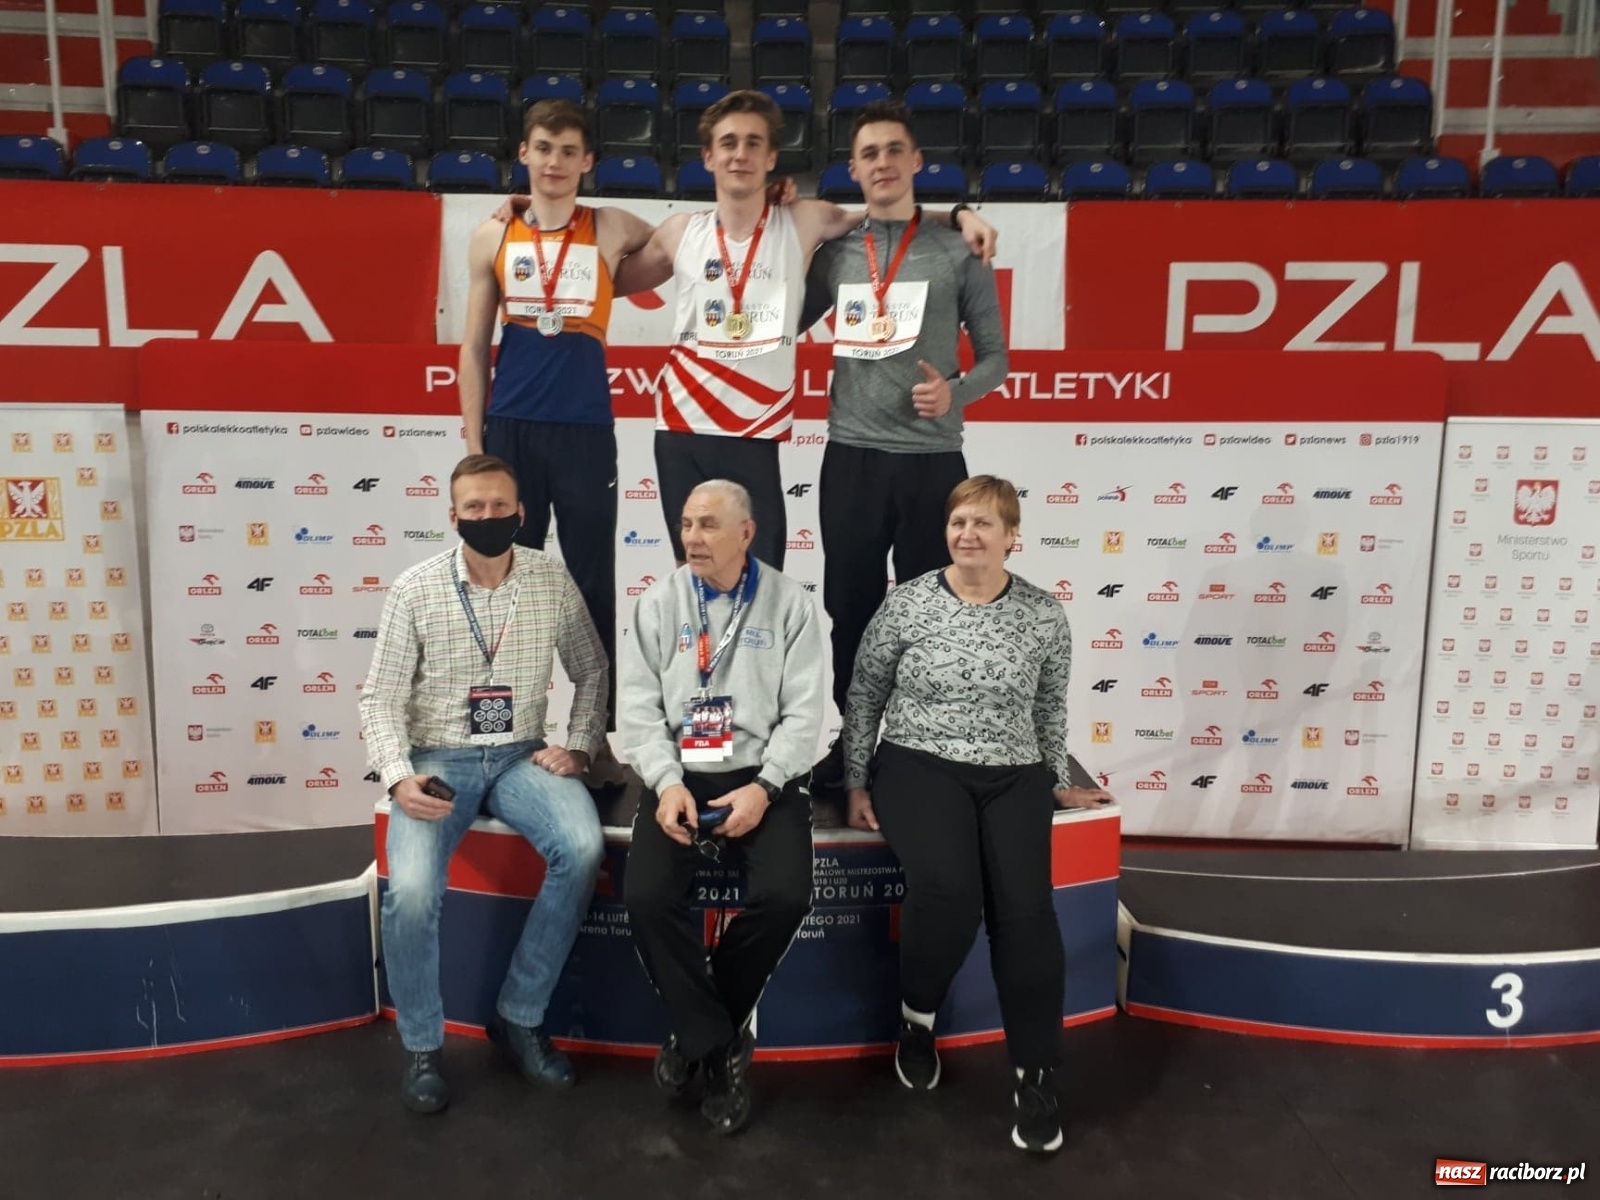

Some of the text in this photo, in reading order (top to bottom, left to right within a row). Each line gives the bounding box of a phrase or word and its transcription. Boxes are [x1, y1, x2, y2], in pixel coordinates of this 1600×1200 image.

[1165, 261, 1600, 361] PZLA
[183, 425, 288, 436] polskalekkoatletyka
[316, 426, 370, 436] pzlawideo
[399, 428, 447, 438] pzlanews
[1090, 435, 1192, 446] polskalekkoatletyka
[1219, 435, 1272, 446] pzlawideo
[1299, 435, 1347, 446] pzlanews
[1374, 435, 1420, 446] pzla1919
[235, 480, 276, 489] 4MOVE
[353, 478, 380, 492] 4F
[407, 488, 438, 496] ORLEN
[787, 484, 812, 498] 4F
[1211, 487, 1238, 500] 4F
[1313, 490, 1353, 499] 4MOVE
[1048, 495, 1077, 503] ORLEN
[1155, 495, 1185, 504] ORLEN
[1371, 496, 1401, 504] ORLEN
[0, 520, 60, 538] PZLA
[354, 537, 384, 545] ORLEN
[1497, 534, 1568, 547] Ministerstwo
[1206, 545, 1235, 553] ORLEN
[1511, 549, 1549, 561] Sportu
[247, 578, 274, 591] 4F
[189, 587, 220, 595] ORLEN
[1097, 584, 1124, 598] 4F
[1310, 586, 1338, 600] 4F
[1149, 593, 1178, 601] ORLEN
[1362, 596, 1392, 604] ORLEN
[248, 636, 278, 644] ORLEN
[353, 630, 378, 639] 4MO
[1194, 637, 1233, 646] 4MOVE
[1305, 644, 1334, 652] ORLEN
[251, 676, 277, 690] 4F
[1092, 680, 1118, 693] 4F
[194, 686, 224, 694] ORLEN
[1142, 689, 1171, 697] ORLEN
[1248, 691, 1277, 699] ORLEN
[1303, 683, 1329, 696] 4F
[1354, 693, 1384, 701] ORLEN
[310, 730, 340, 738] OLIMP
[248, 776, 287, 785] 4MOVE
[307, 780, 337, 788] ORLEN
[1137, 782, 1166, 790] ORLEN
[1191, 775, 1217, 788] 4F
[1291, 782, 1329, 790] 4MOVE
[197, 784, 227, 792] ORLEN
[814, 857, 839, 868] PZLA
[814, 869, 846, 877] HALOWE
[847, 866, 897, 876] MISTRZOSTWA
[698, 887, 739, 900] 2021
[814, 881, 905, 900] TORUŃ 20
[607, 911, 630, 924] LUTE
[837, 914, 861, 925] 2021
[610, 926, 632, 937] Toru
[796, 928, 825, 939] Toruń
[1486, 972, 1523, 1028] 3
